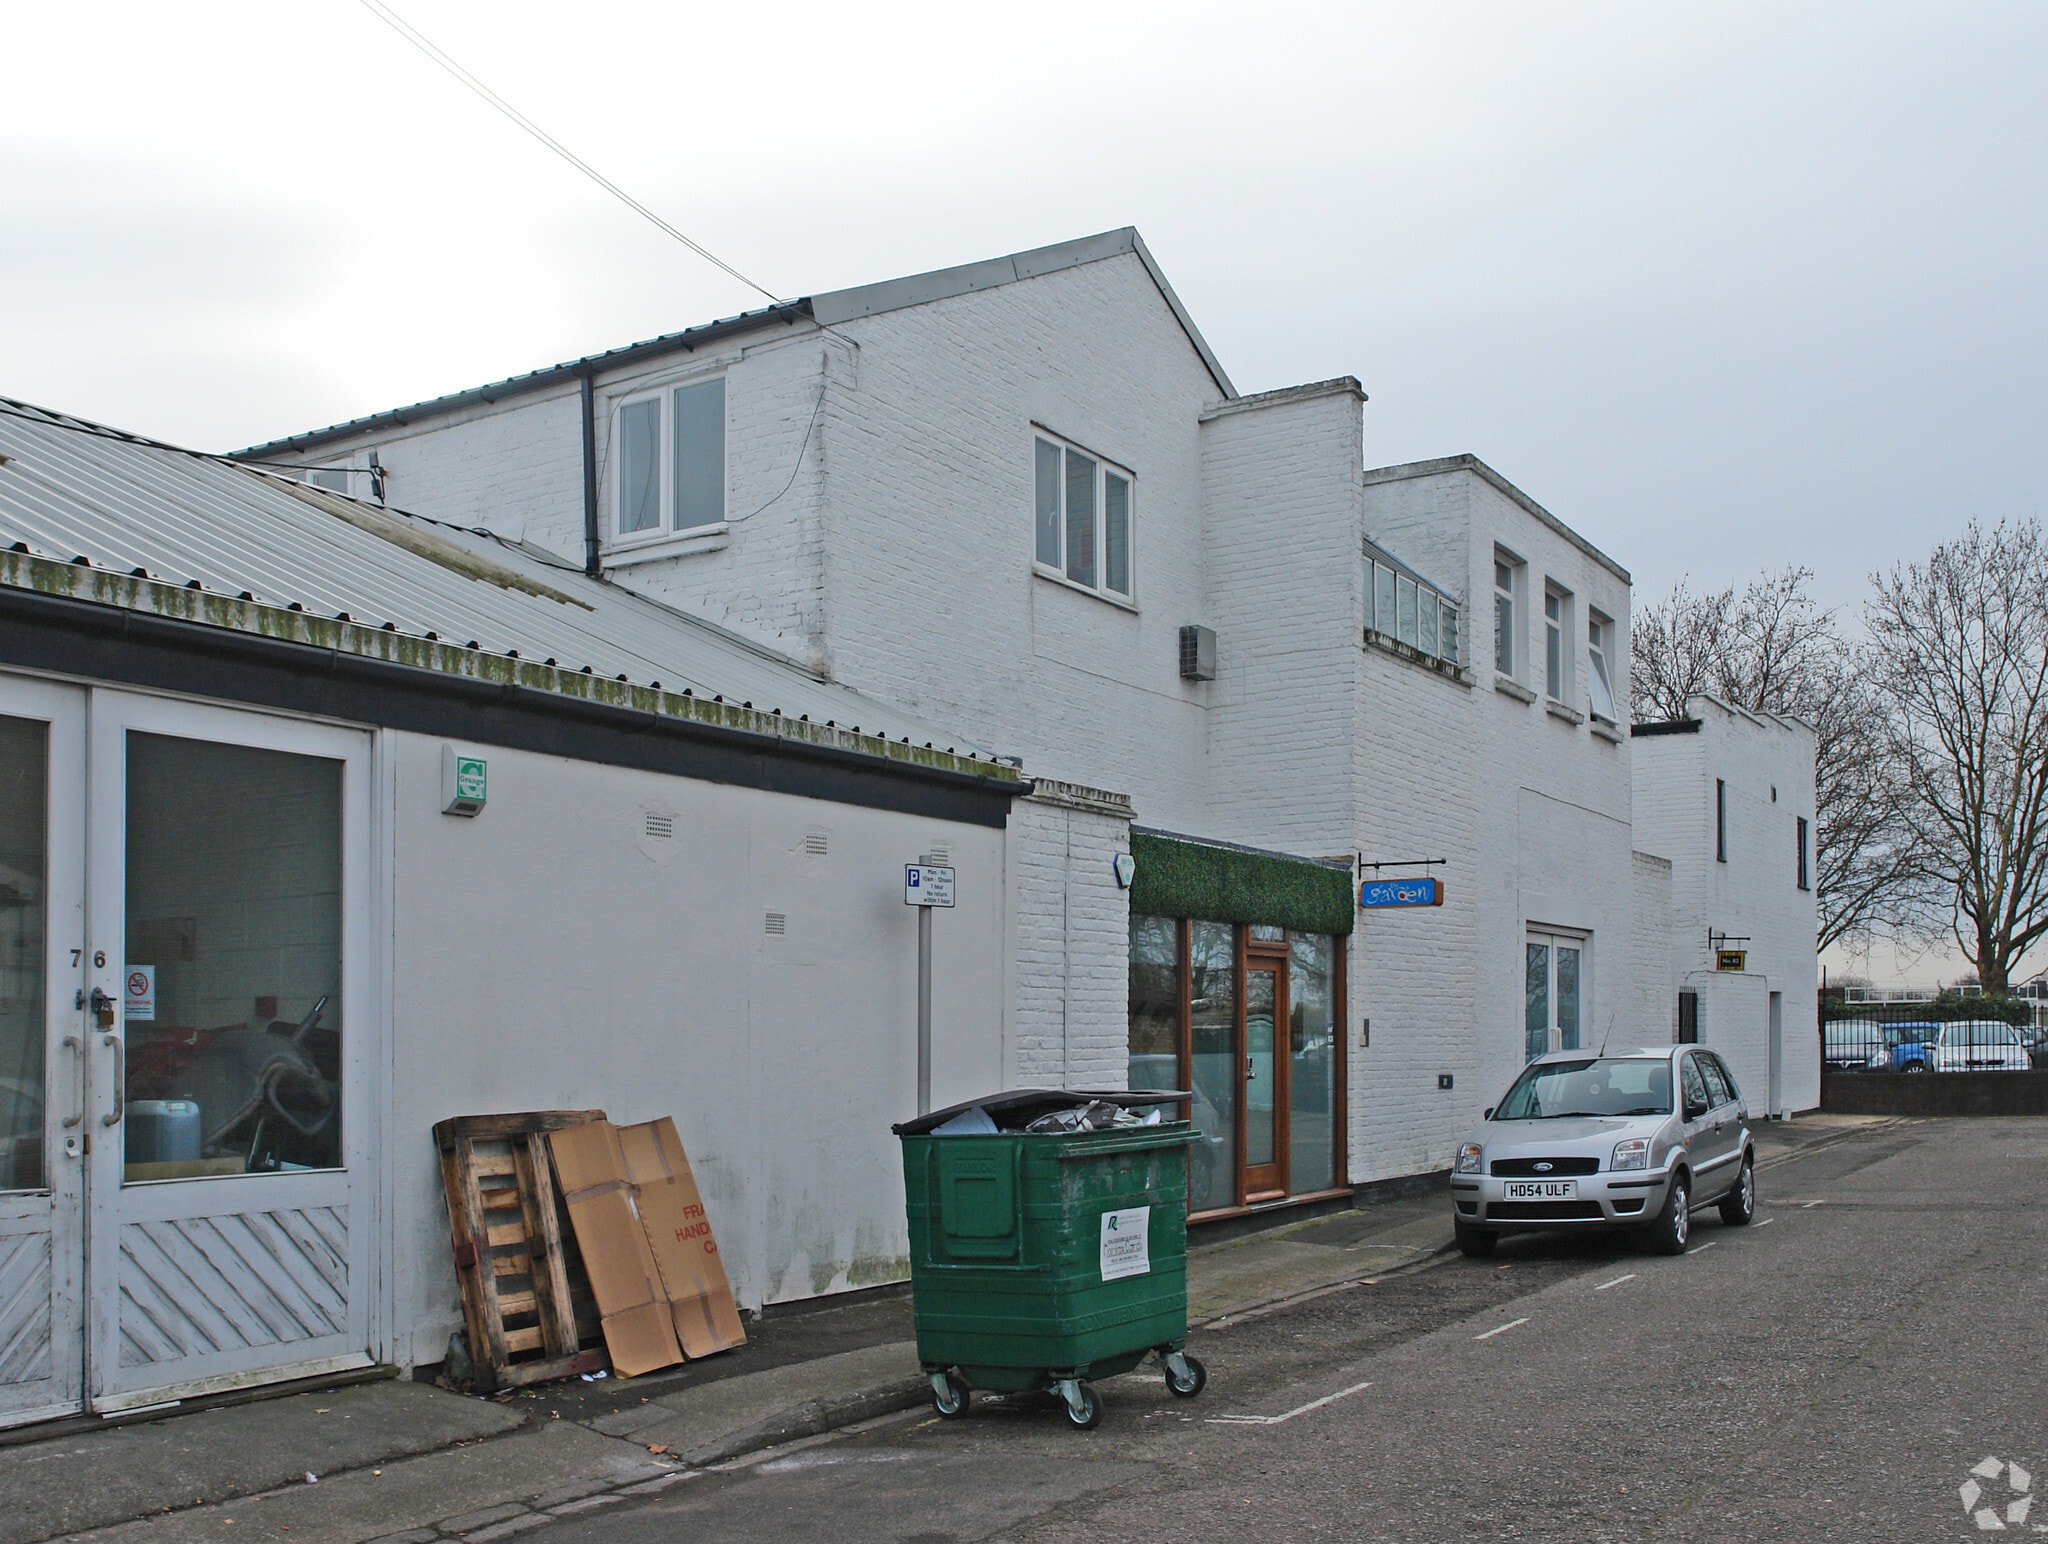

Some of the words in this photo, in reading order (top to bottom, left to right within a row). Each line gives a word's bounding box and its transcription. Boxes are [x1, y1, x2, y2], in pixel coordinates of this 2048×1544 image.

[910, 871, 918, 886] P
[1366, 885, 1431, 904] garden
[70, 949, 81, 968] 7
[94, 950, 106, 968] 6
[1510, 1184, 1542, 1197] HD54
[1546, 1183, 1571, 1196] ULF
